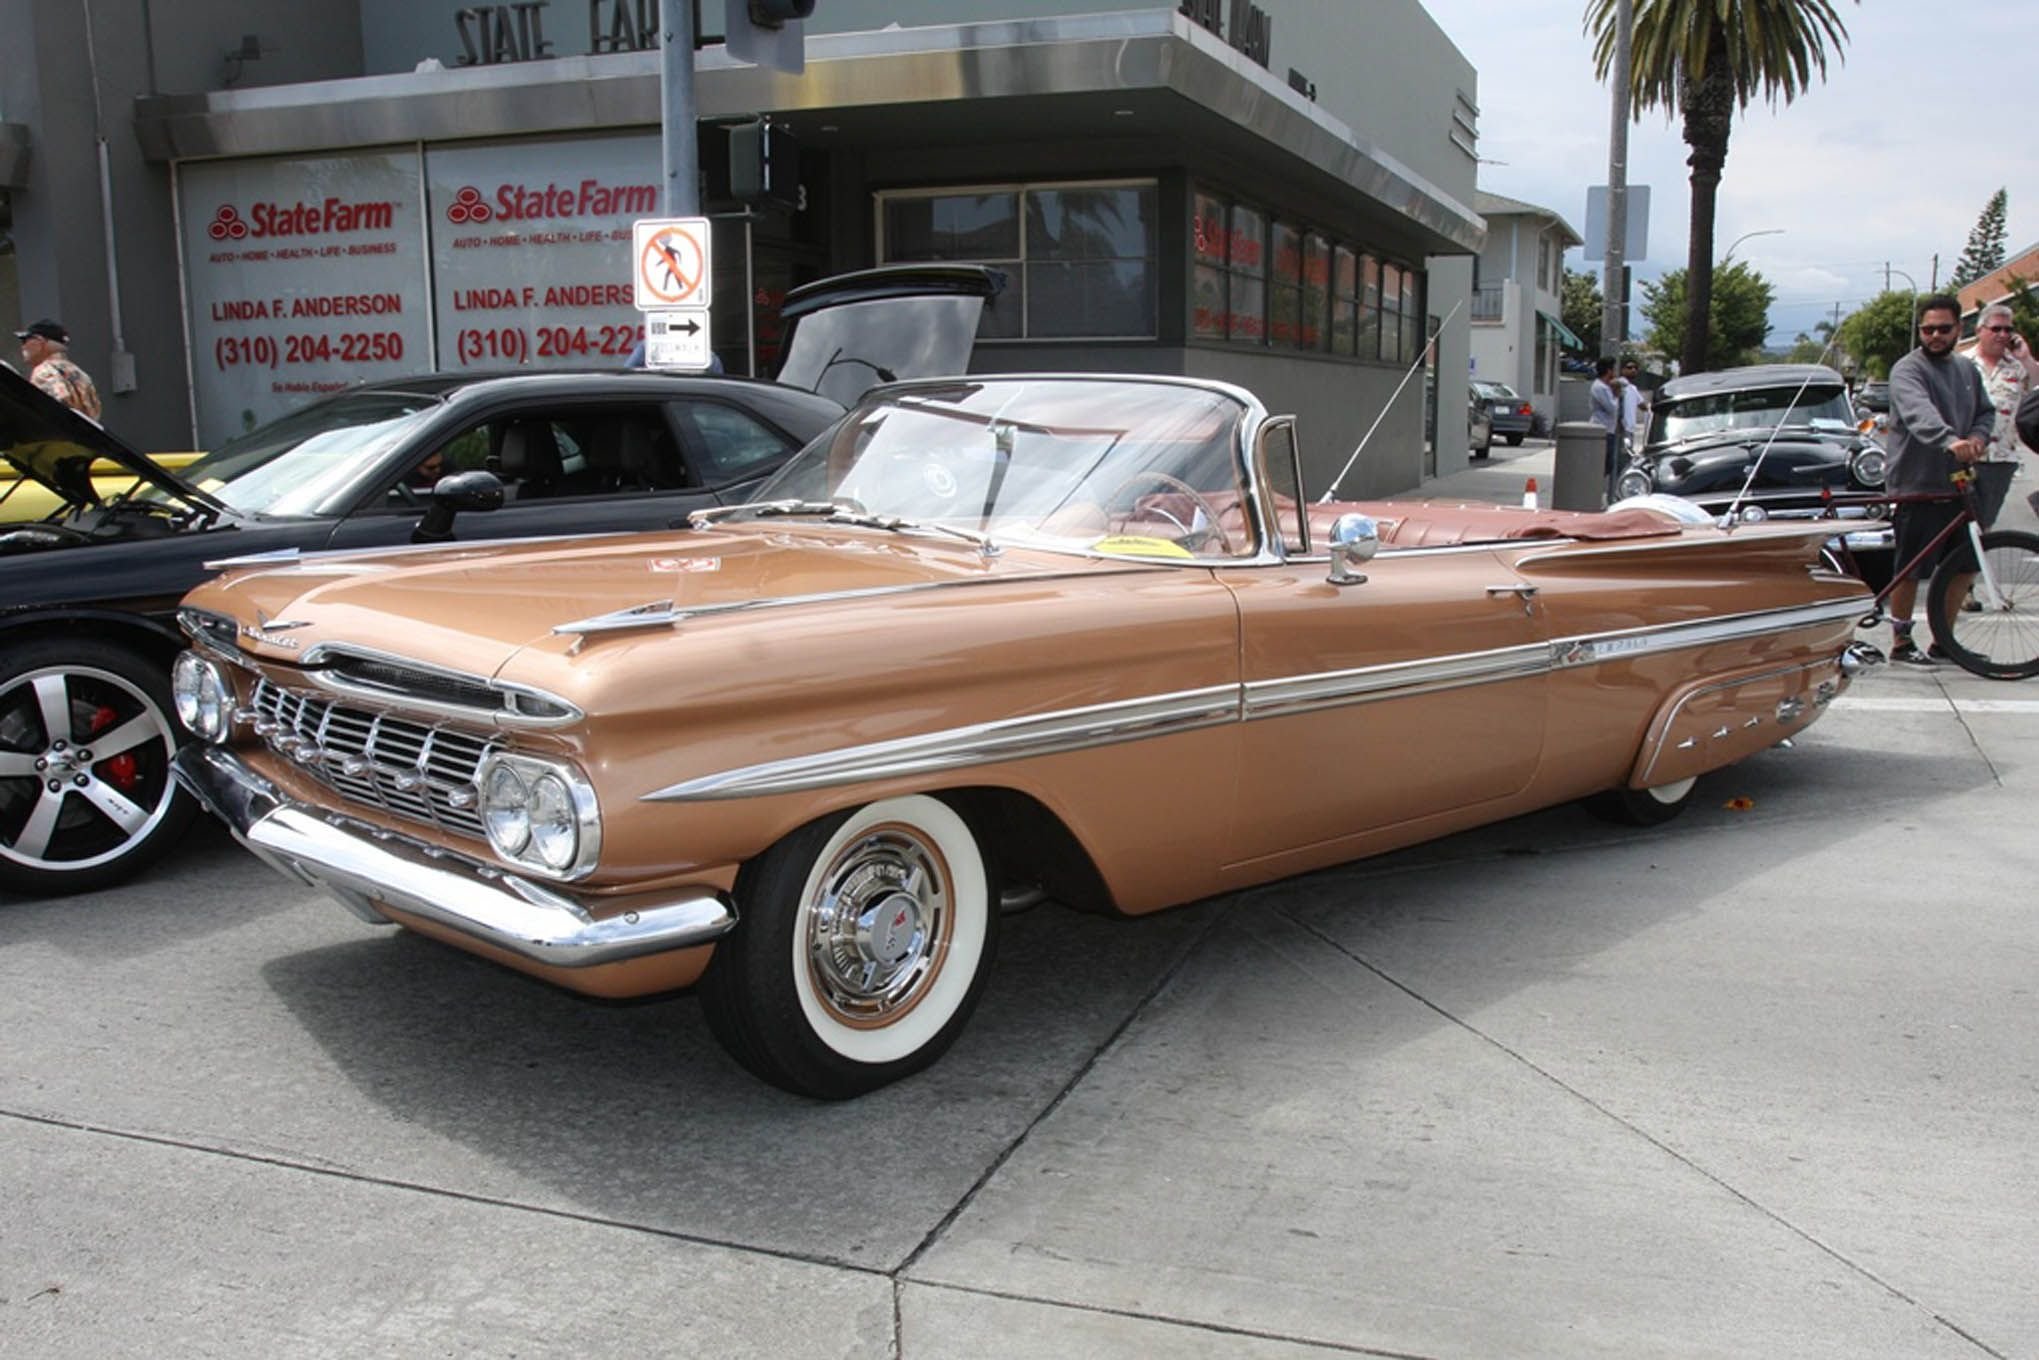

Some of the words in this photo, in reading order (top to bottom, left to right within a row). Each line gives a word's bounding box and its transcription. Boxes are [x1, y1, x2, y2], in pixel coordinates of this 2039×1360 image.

[454, 2, 554, 65] STATE
[209, 252, 235, 264] AUTO
[275, 247, 313, 260] HEALTH
[320, 245, 341, 258] LIFE
[348, 242, 397, 256] BUSINESS
[453, 237, 481, 249] AUTO
[490, 234, 521, 247] HOME
[528, 231, 571, 245] HEALTH
[579, 230, 603, 243] LIFE
[211, 300, 268, 321] LINDA
[272, 299, 288, 319] F.
[292, 294, 402, 318] ANDERSON
[454, 288, 517, 311] LINDA
[523, 287, 539, 308] F.
[543, 284, 635, 307] ANDERS
[215, 335, 279, 371] (310)
[285, 331, 404, 363] 204-2250
[457, 329, 528, 366] (310)
